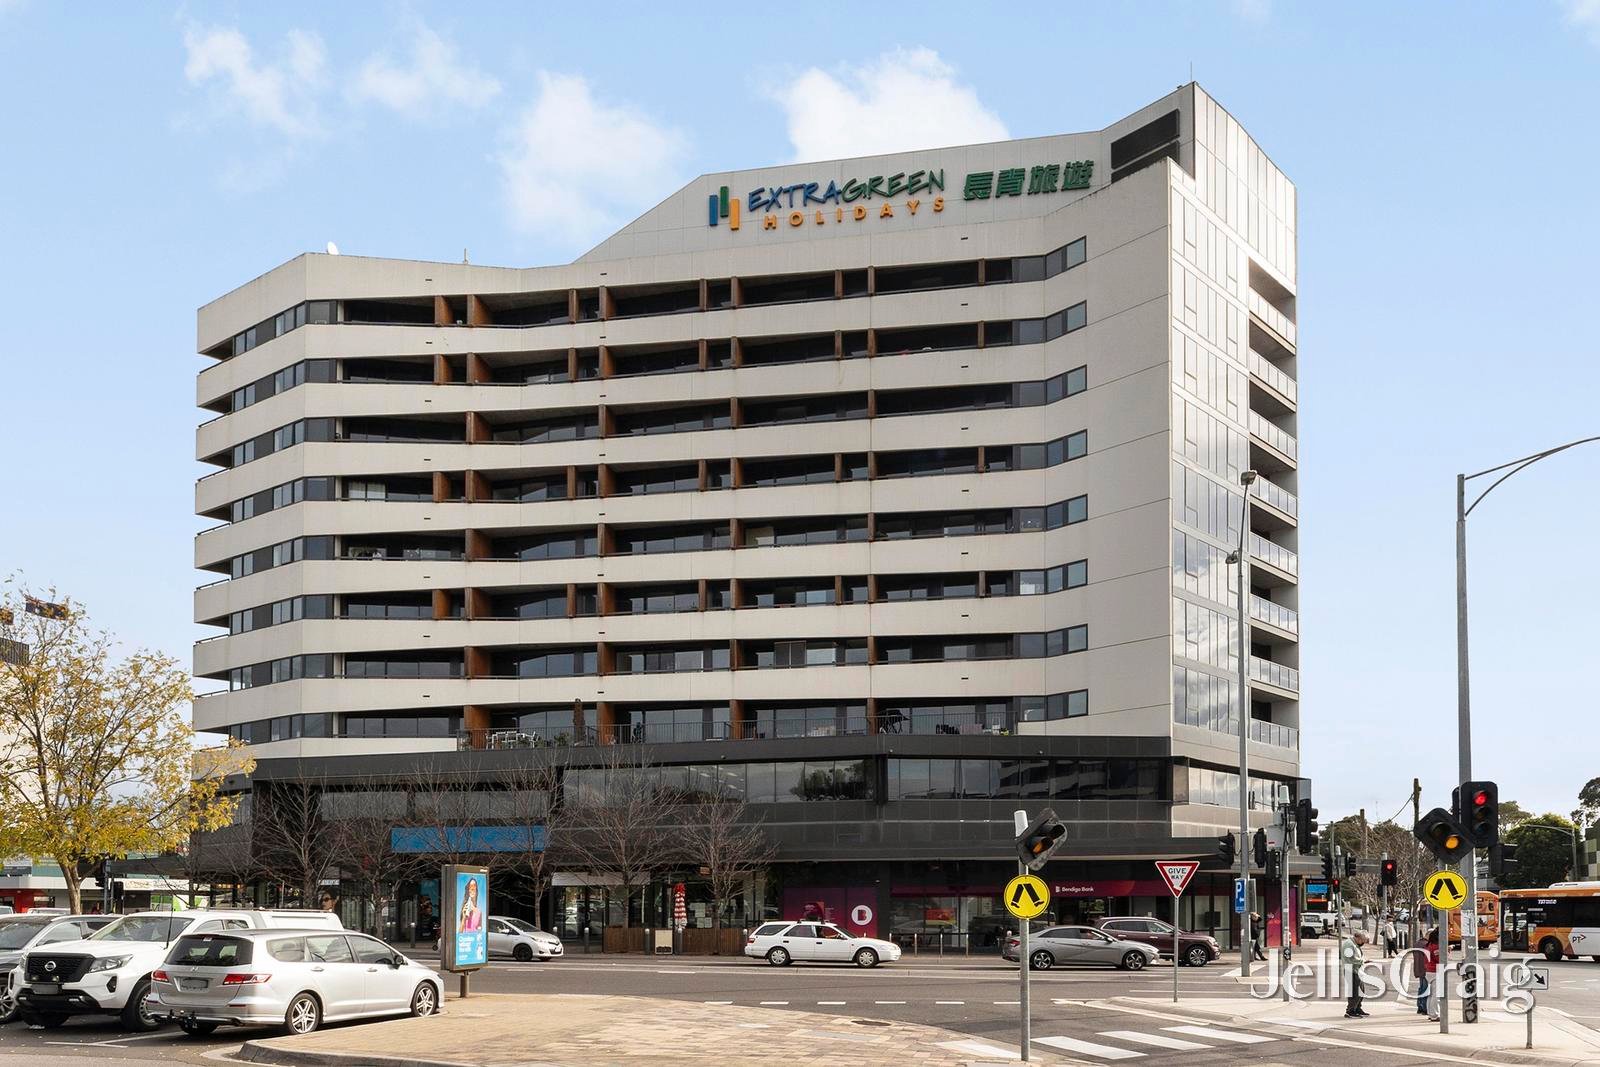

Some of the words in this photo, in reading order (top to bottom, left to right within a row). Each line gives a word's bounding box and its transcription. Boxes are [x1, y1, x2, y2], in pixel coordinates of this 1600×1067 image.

[748, 168, 945, 212] EXTRAGREEN
[963, 160, 1094, 200] 長青旅遊
[763, 196, 945, 230] HOLIDAYS
[1235, 881, 1242, 899] P
